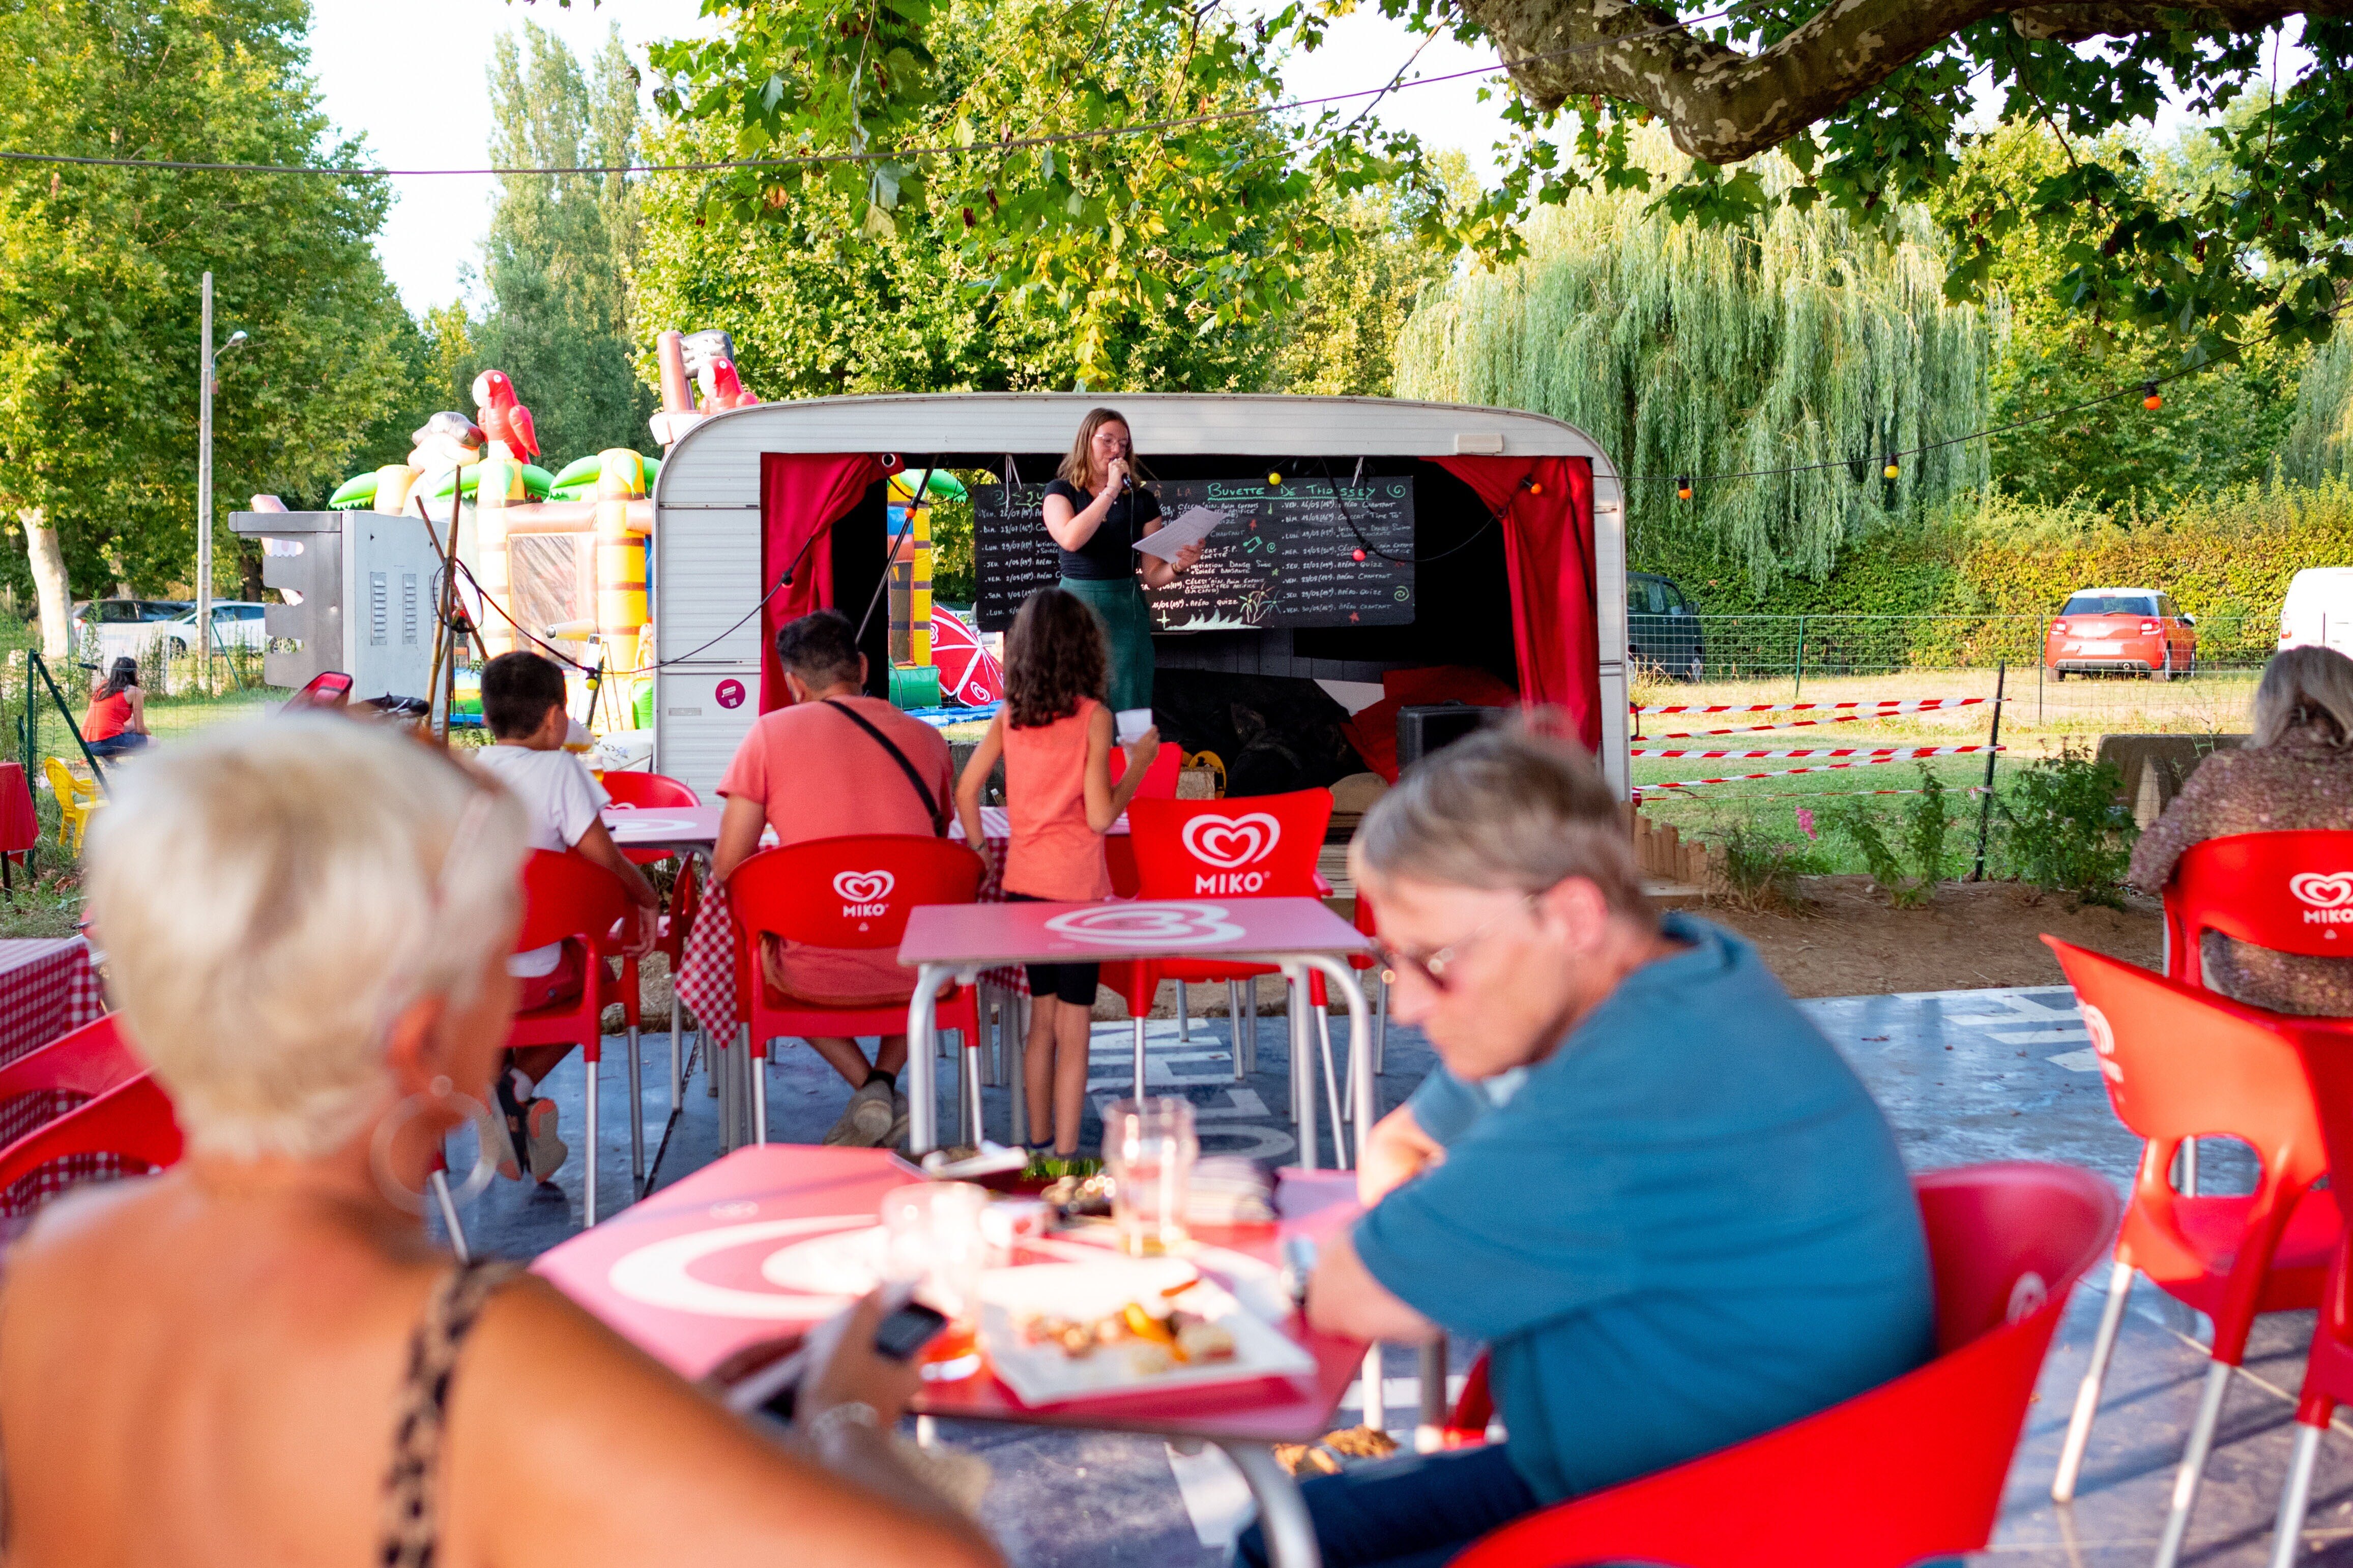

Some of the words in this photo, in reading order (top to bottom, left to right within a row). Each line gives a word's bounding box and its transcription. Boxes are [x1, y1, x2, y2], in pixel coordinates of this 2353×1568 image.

[1207, 482, 1265, 497] BUVETTE
[1280, 484, 1297, 497] DE
[1305, 483, 1376, 499] THOSSEY
[1035, 540, 1058, 548] INITIATIO
[1196, 871, 1263, 894] MIKO
[843, 903, 885, 918] MIKO
[2303, 908, 2353, 924] MIKO
